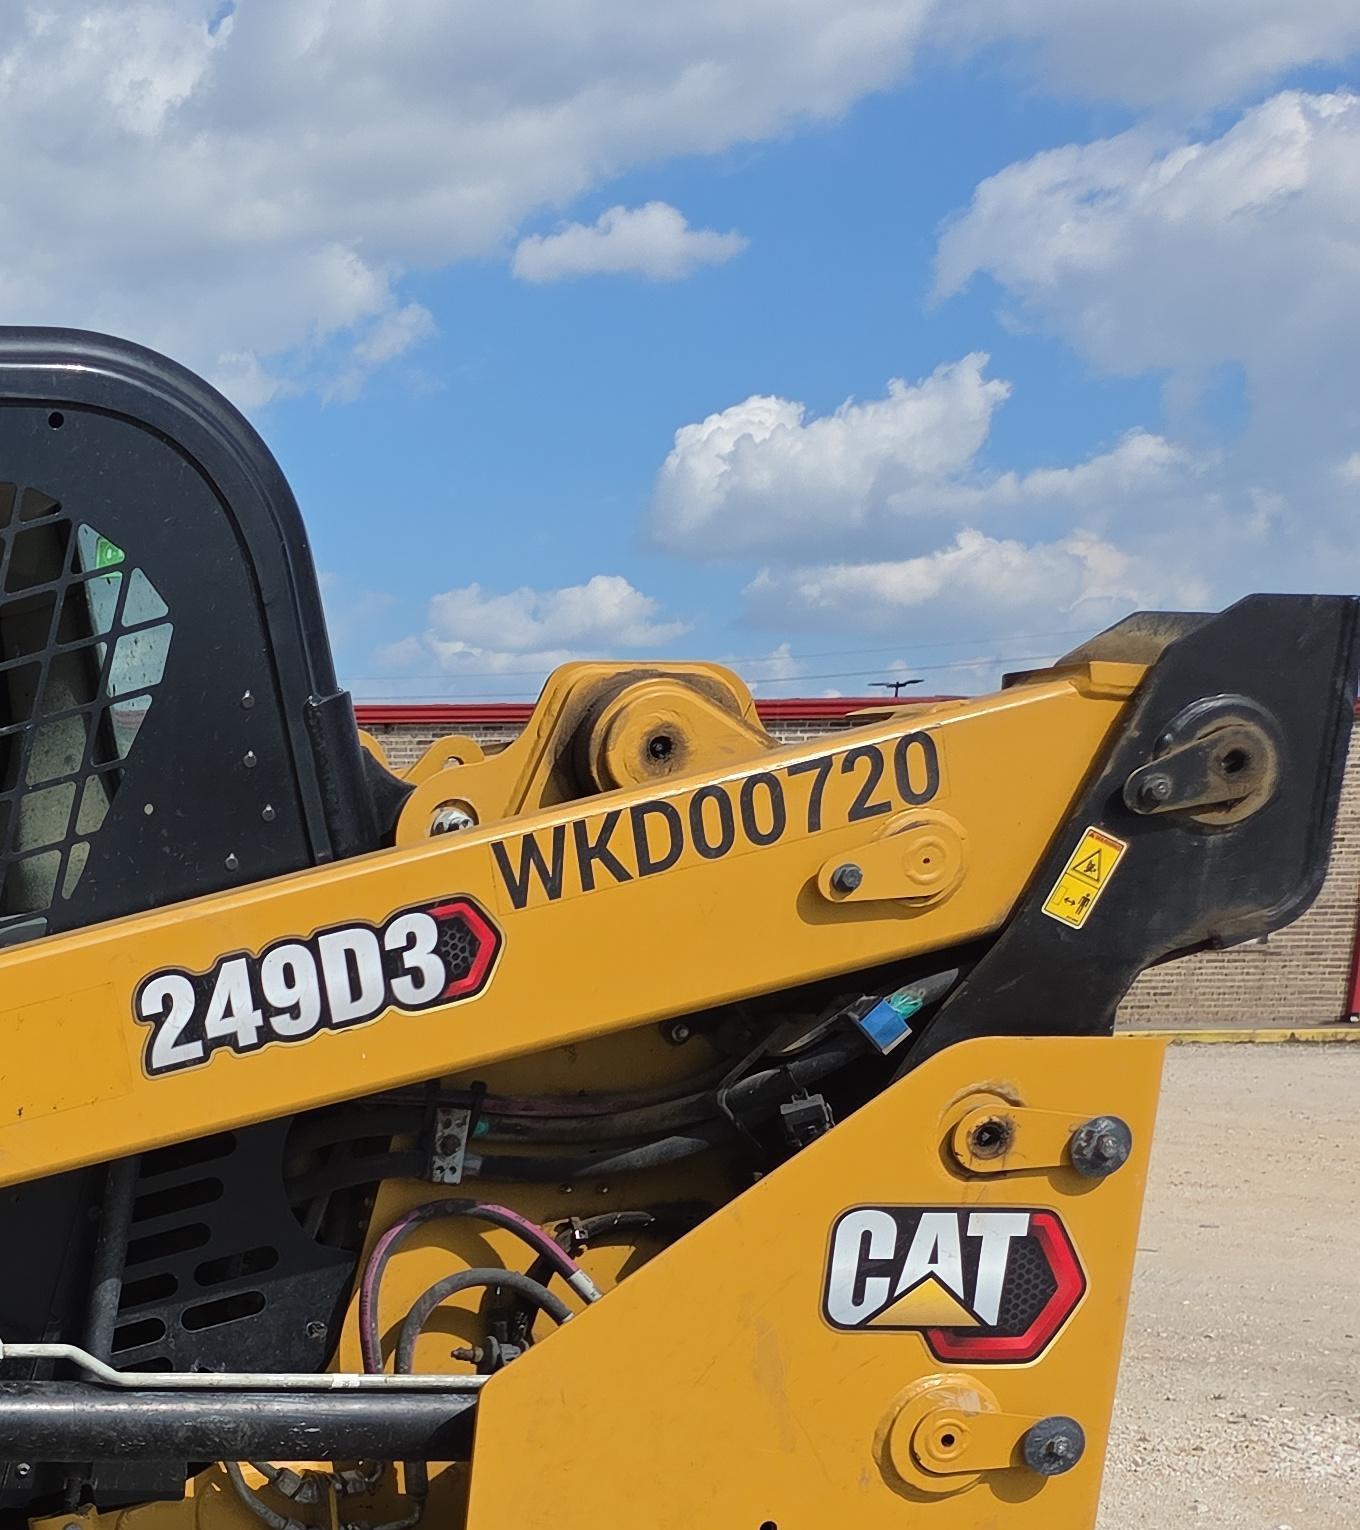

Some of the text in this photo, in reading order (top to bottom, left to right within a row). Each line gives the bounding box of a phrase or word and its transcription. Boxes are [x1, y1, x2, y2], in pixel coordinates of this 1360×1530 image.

[489, 731, 940, 910] WKD00720
[140, 913, 446, 1069] 249D3
[828, 1209, 1030, 1326] CAT
